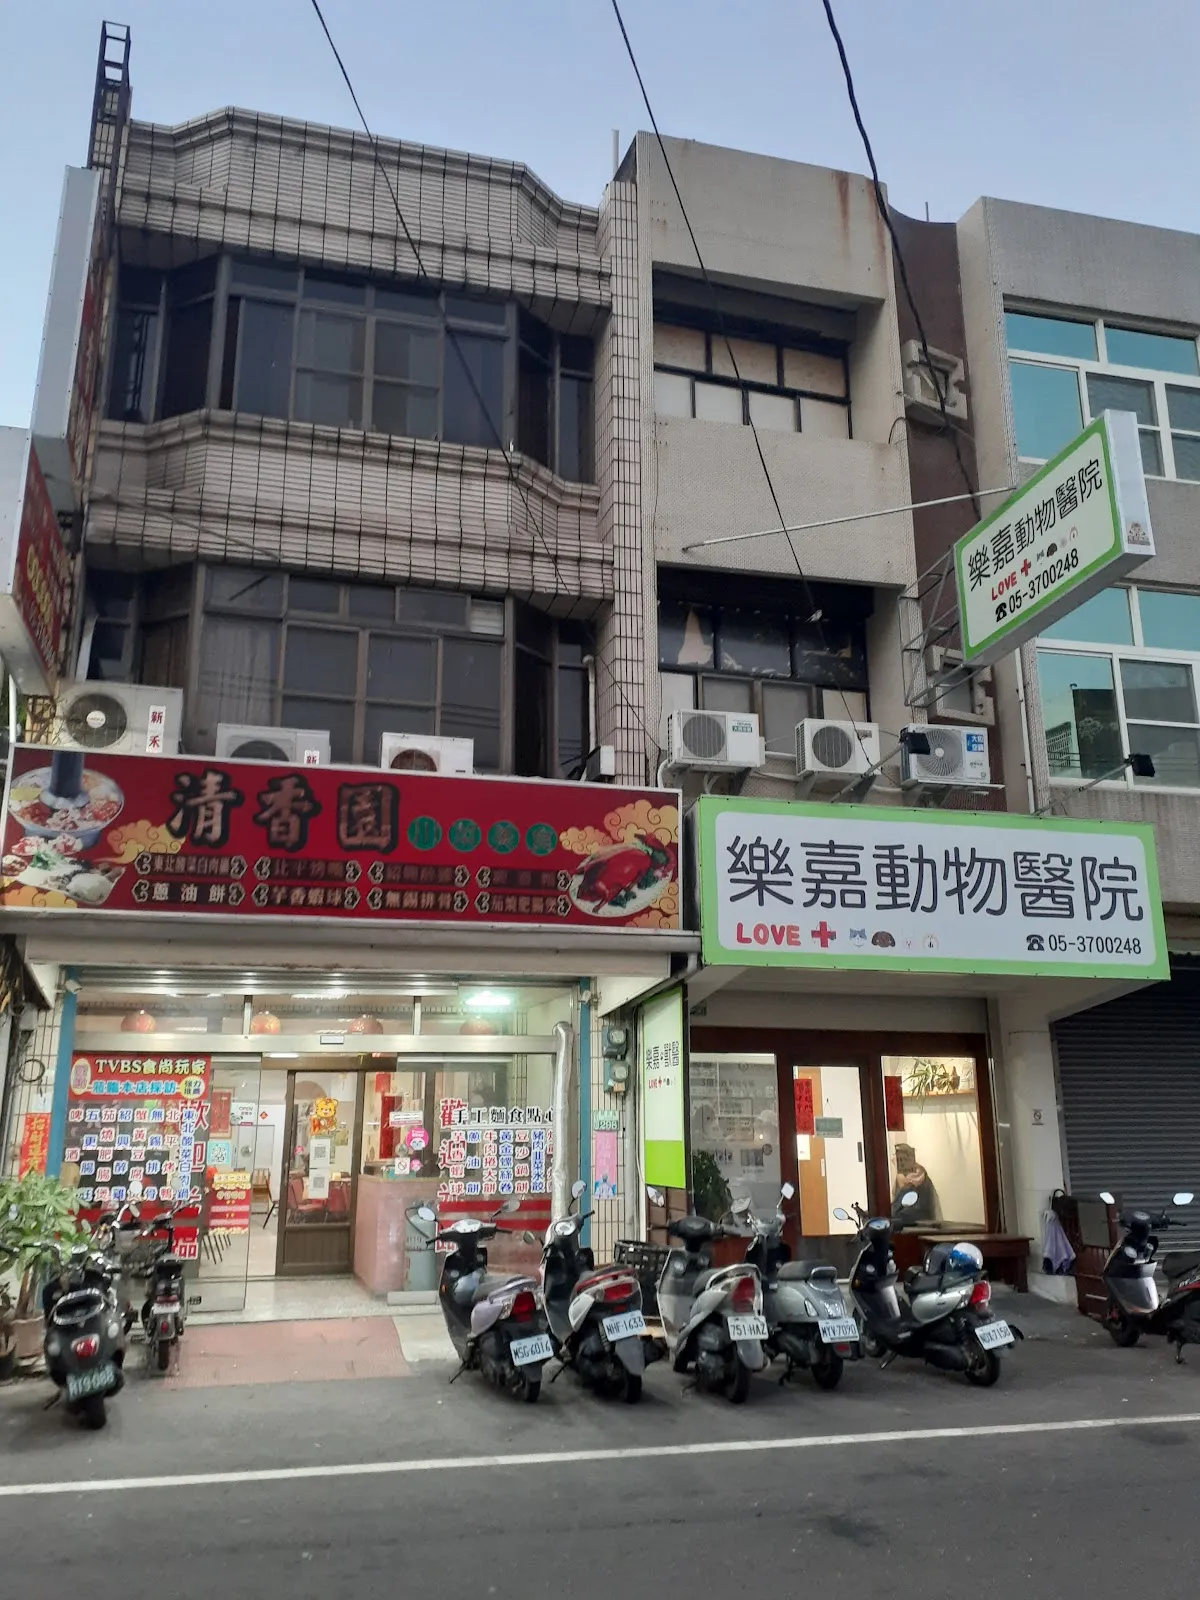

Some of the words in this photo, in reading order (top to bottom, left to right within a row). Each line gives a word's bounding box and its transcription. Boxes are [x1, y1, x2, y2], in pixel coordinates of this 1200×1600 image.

[967, 460, 1103, 591] 樂嘉動物醫院
[991, 572, 1017, 601] LOVE
[1008, 548, 1079, 613] 05-3700248
[167, 769, 399, 852] 清香園
[386, 890, 452, 909] 無錫排骨
[727, 835, 1143, 921] 樂嘉動物醫院
[736, 922, 801, 946] LOVE
[1049, 934, 1142, 955] 05-3700248
[112, 1109, 132, 1200] 紹興醉雞
[145, 1109, 164, 1200] 無錫排骨
